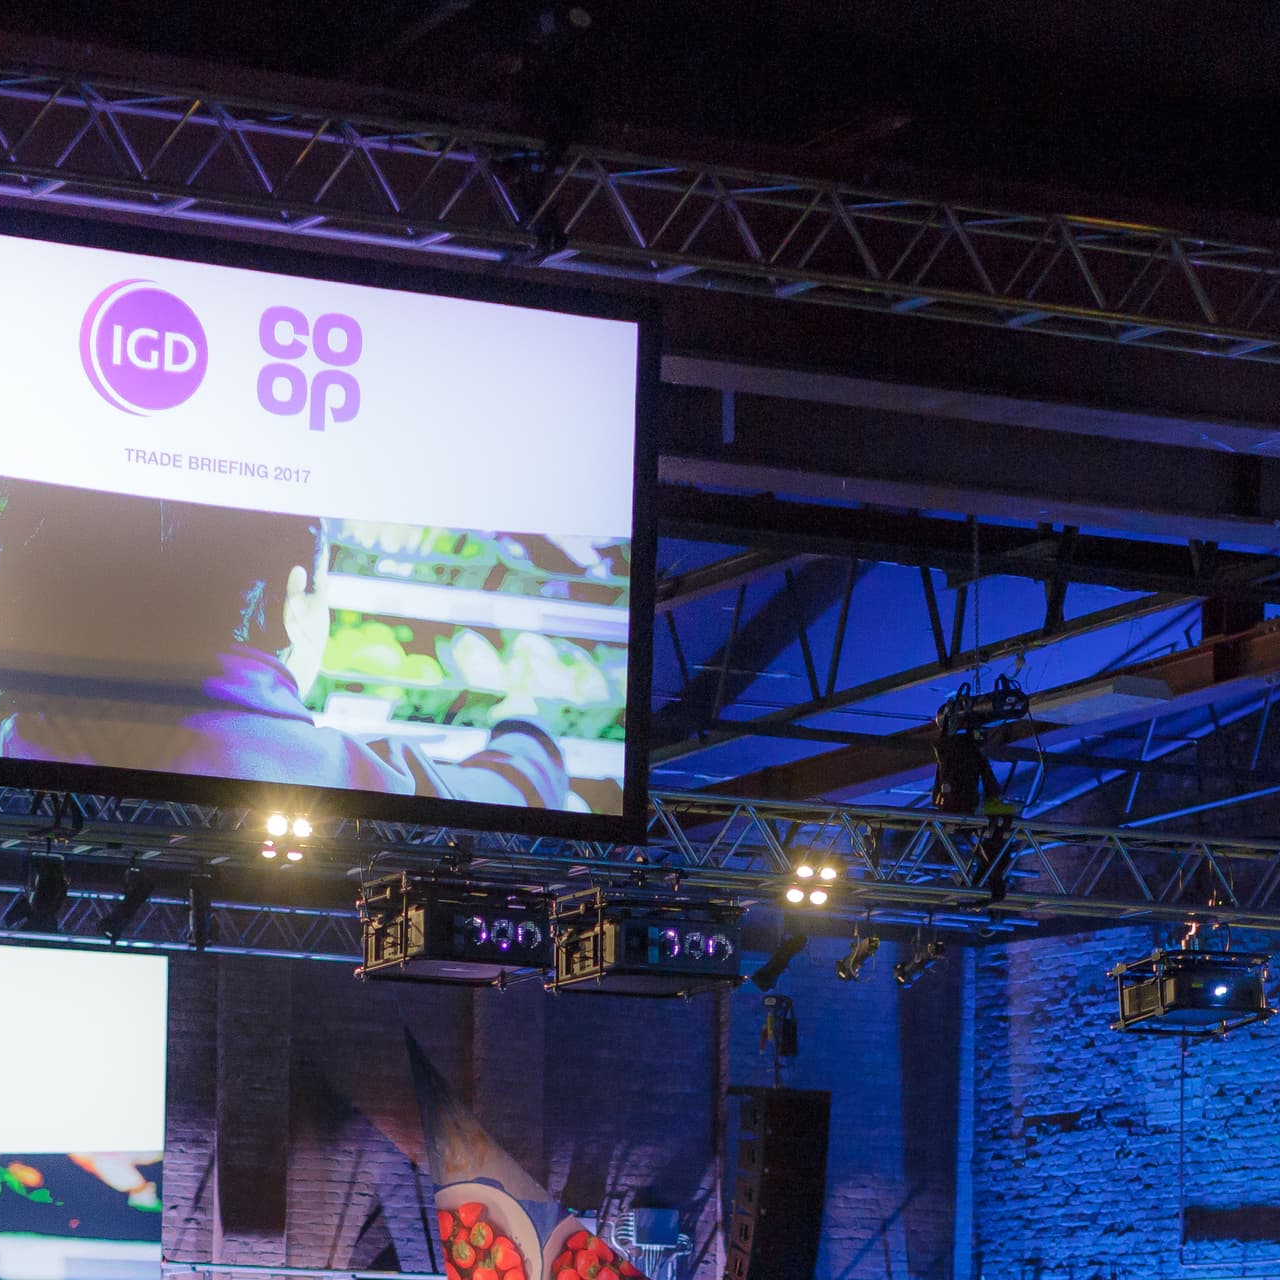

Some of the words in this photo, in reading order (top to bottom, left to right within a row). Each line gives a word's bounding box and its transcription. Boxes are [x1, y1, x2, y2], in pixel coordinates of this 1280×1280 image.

[112, 324, 197, 373] IGD
[124, 448, 183, 469] TRADE
[188, 456, 269, 479] BRIEFING
[274, 466, 311, 484] 2017
